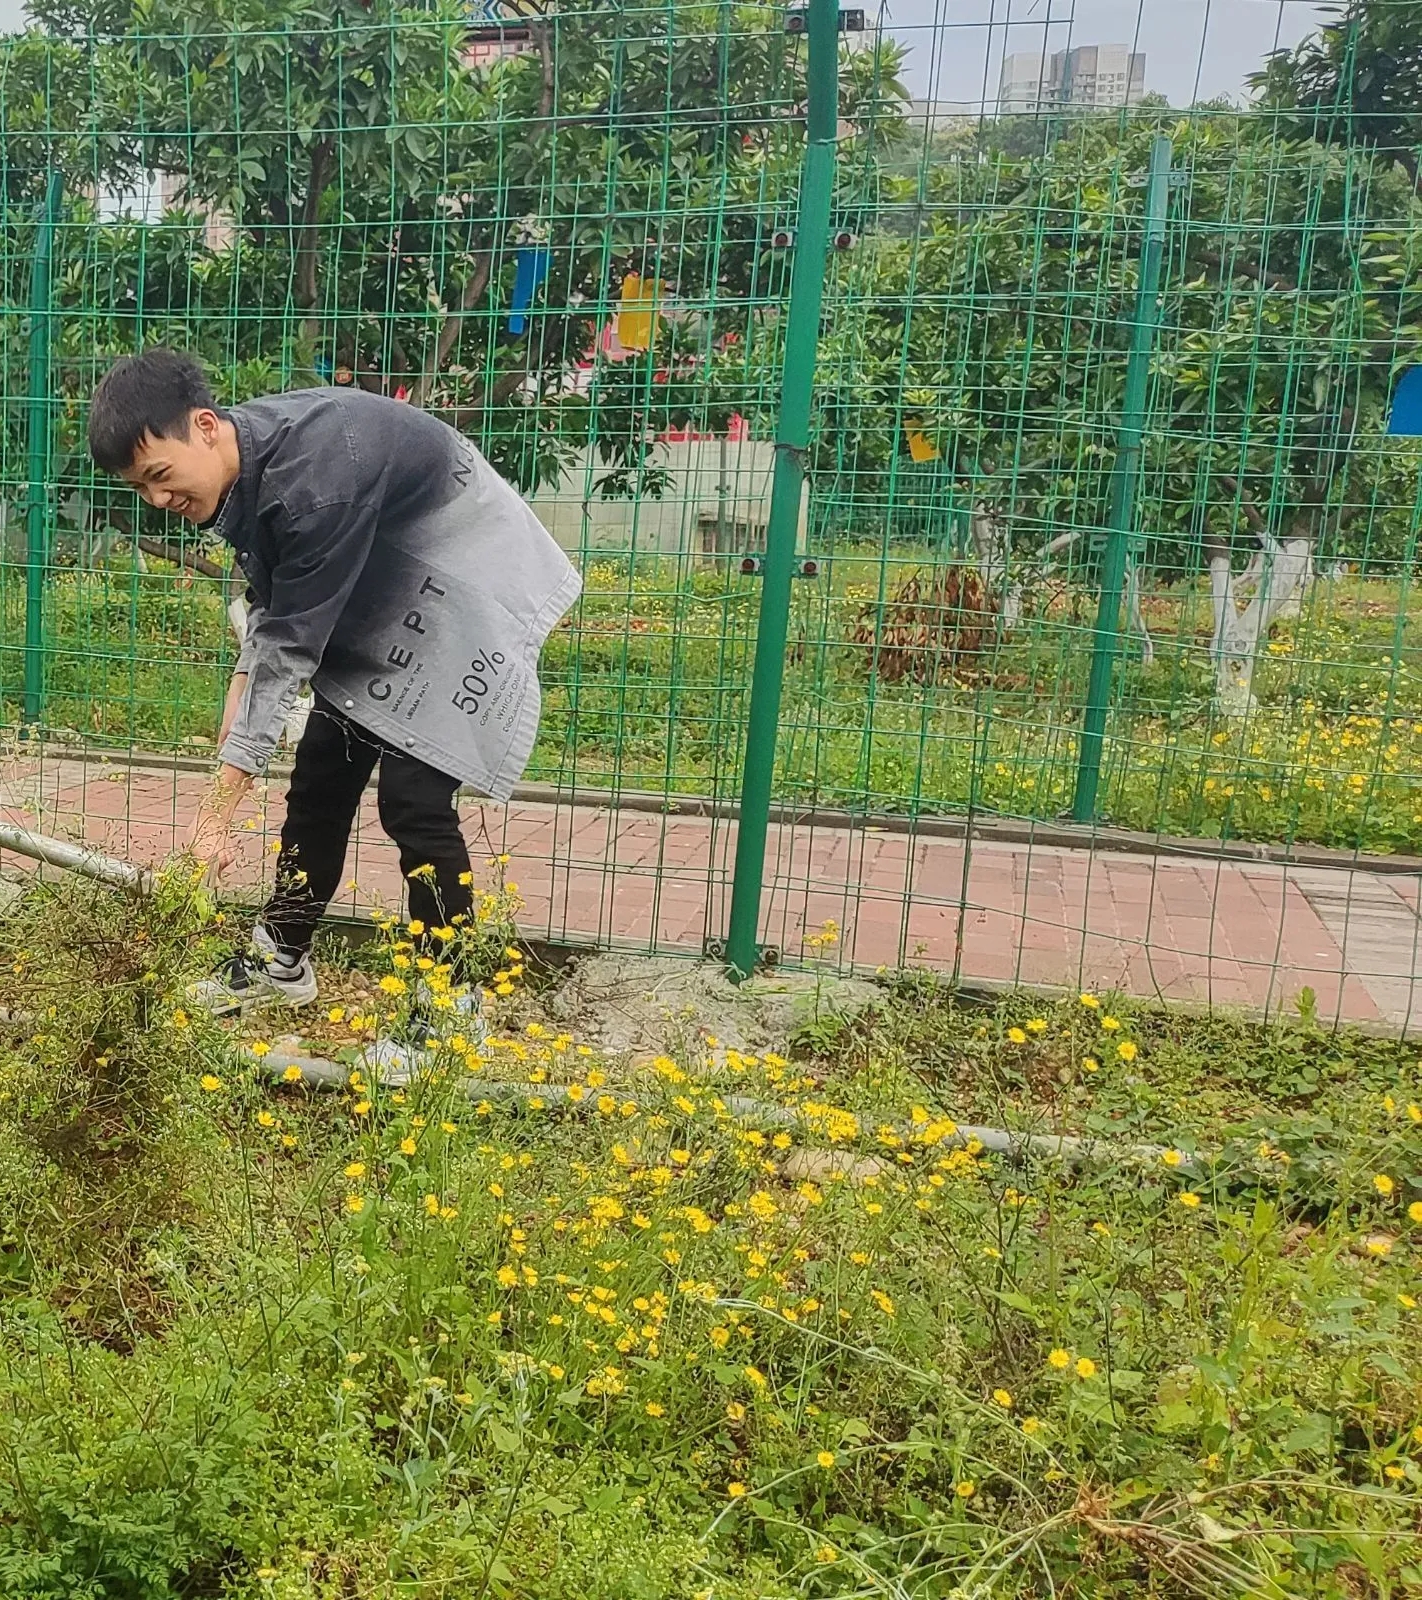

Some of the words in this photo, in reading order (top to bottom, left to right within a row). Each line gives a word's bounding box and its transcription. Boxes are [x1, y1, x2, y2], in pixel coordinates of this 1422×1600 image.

[413, 663, 423, 674] THE
[451, 648, 505, 715] 50%
[479, 707, 492, 726] COPY
[491, 691, 502, 707] AND
[496, 691, 514, 720] WHICH
